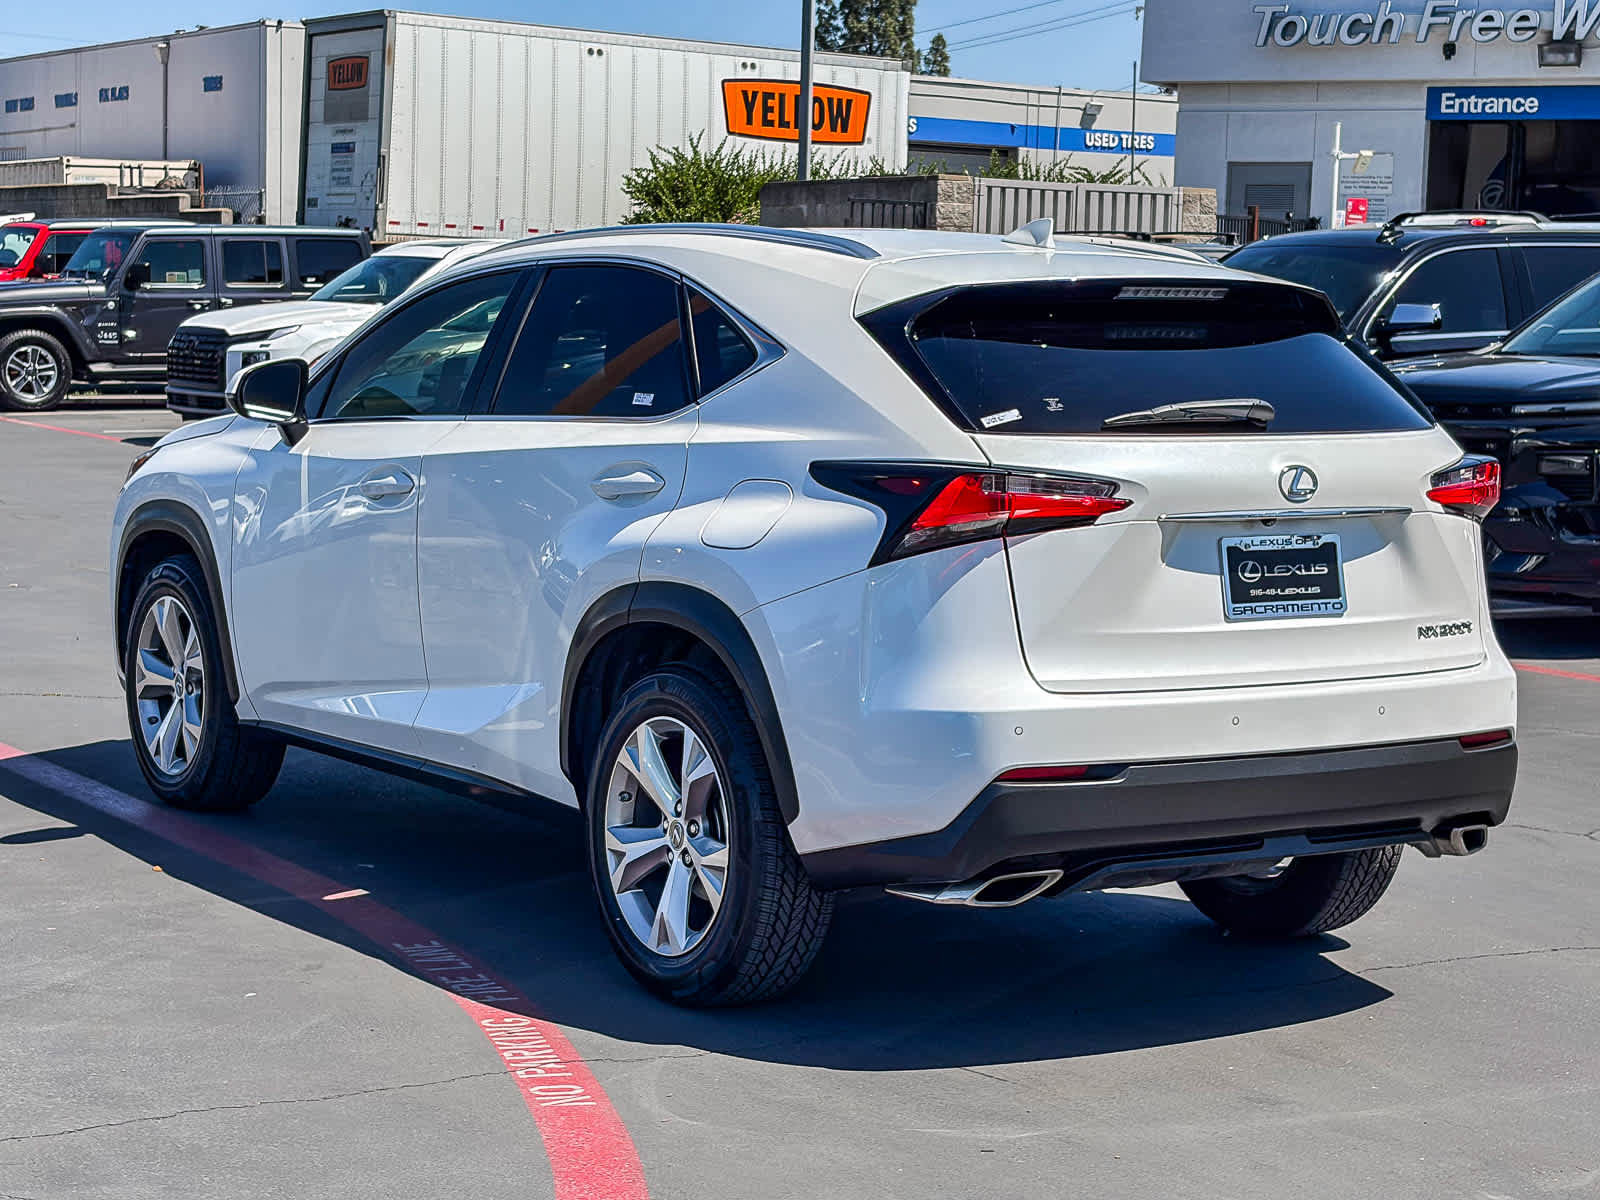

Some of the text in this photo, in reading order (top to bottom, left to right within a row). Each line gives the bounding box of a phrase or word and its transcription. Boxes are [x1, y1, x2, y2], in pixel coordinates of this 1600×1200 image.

[1253, 0, 1600, 47] Touch Free W
[332, 62, 364, 85] YELLOW
[1440, 92, 1540, 114] Entrance
[1085, 132, 1154, 150] USED TIRES
[1251, 538, 1292, 547] LEXUS
[1264, 563, 1329, 577] LEXUS
[1232, 601, 1343, 616] SACRAMENTO
[481, 1017, 573, 1079] PARKING
[529, 1084, 598, 1107] NO
